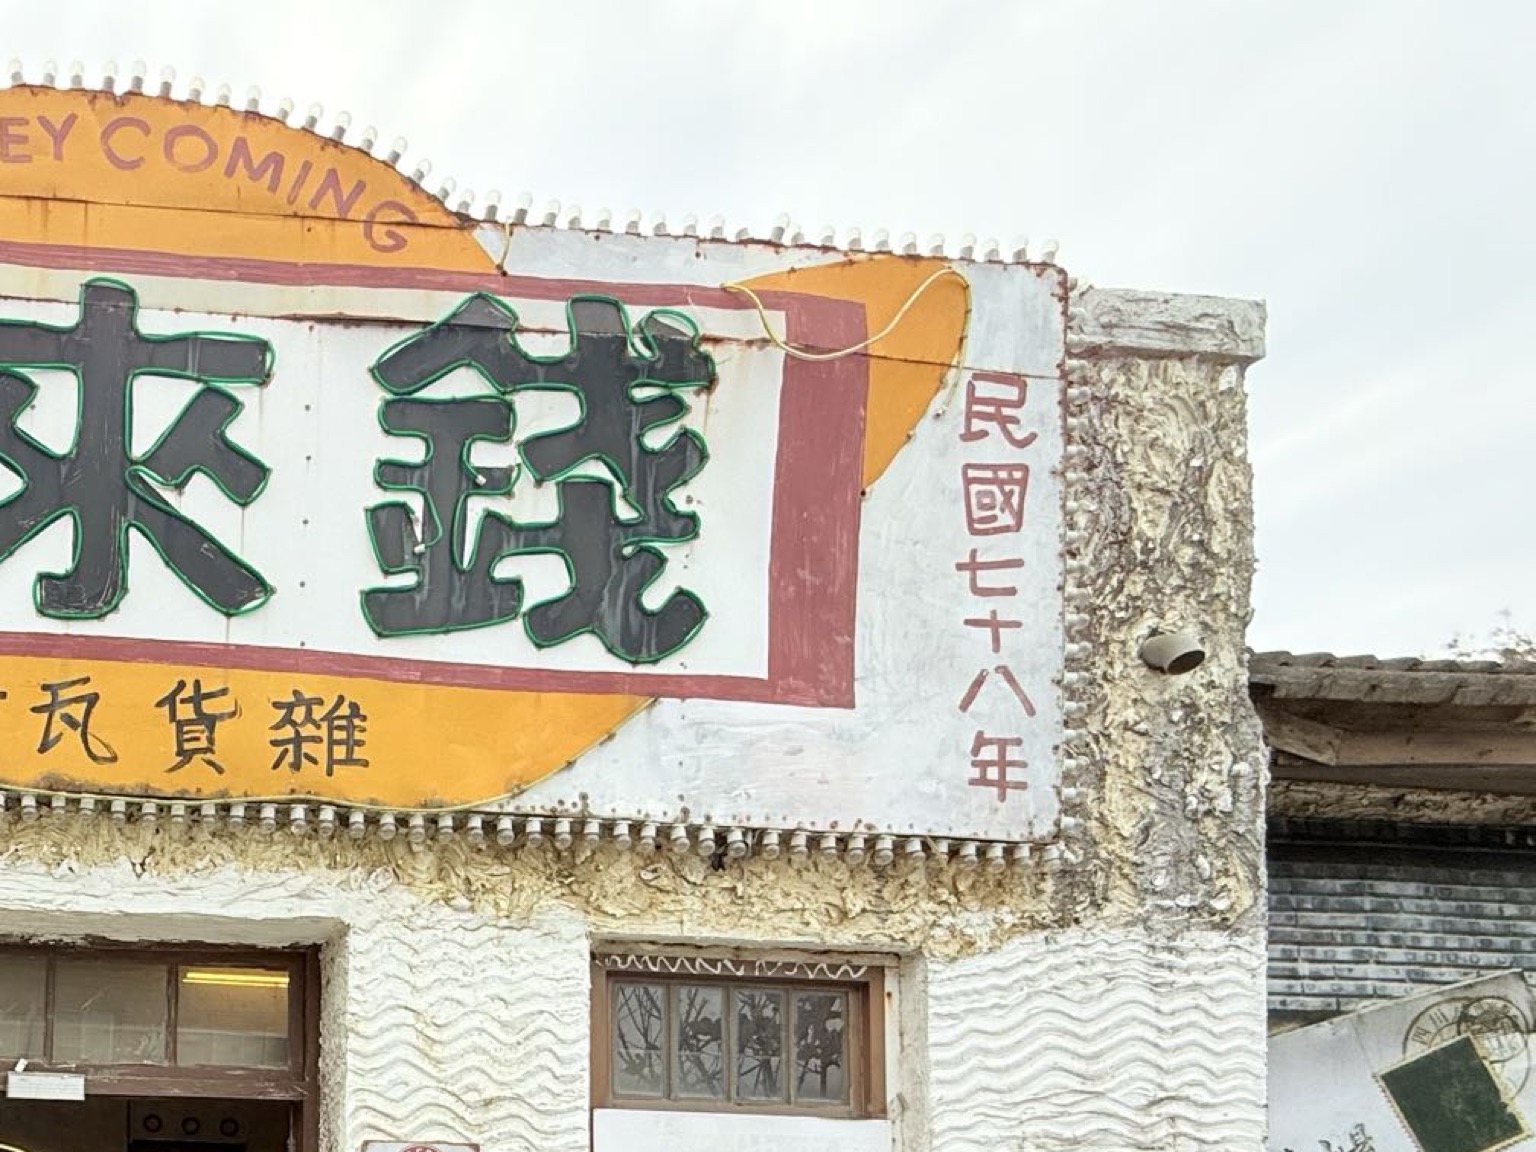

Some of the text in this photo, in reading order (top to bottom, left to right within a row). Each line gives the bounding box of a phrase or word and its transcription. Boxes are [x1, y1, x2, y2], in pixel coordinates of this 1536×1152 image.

[99, 115, 420, 254] COMING
[955, 372, 1038, 804] 民國七十八年
